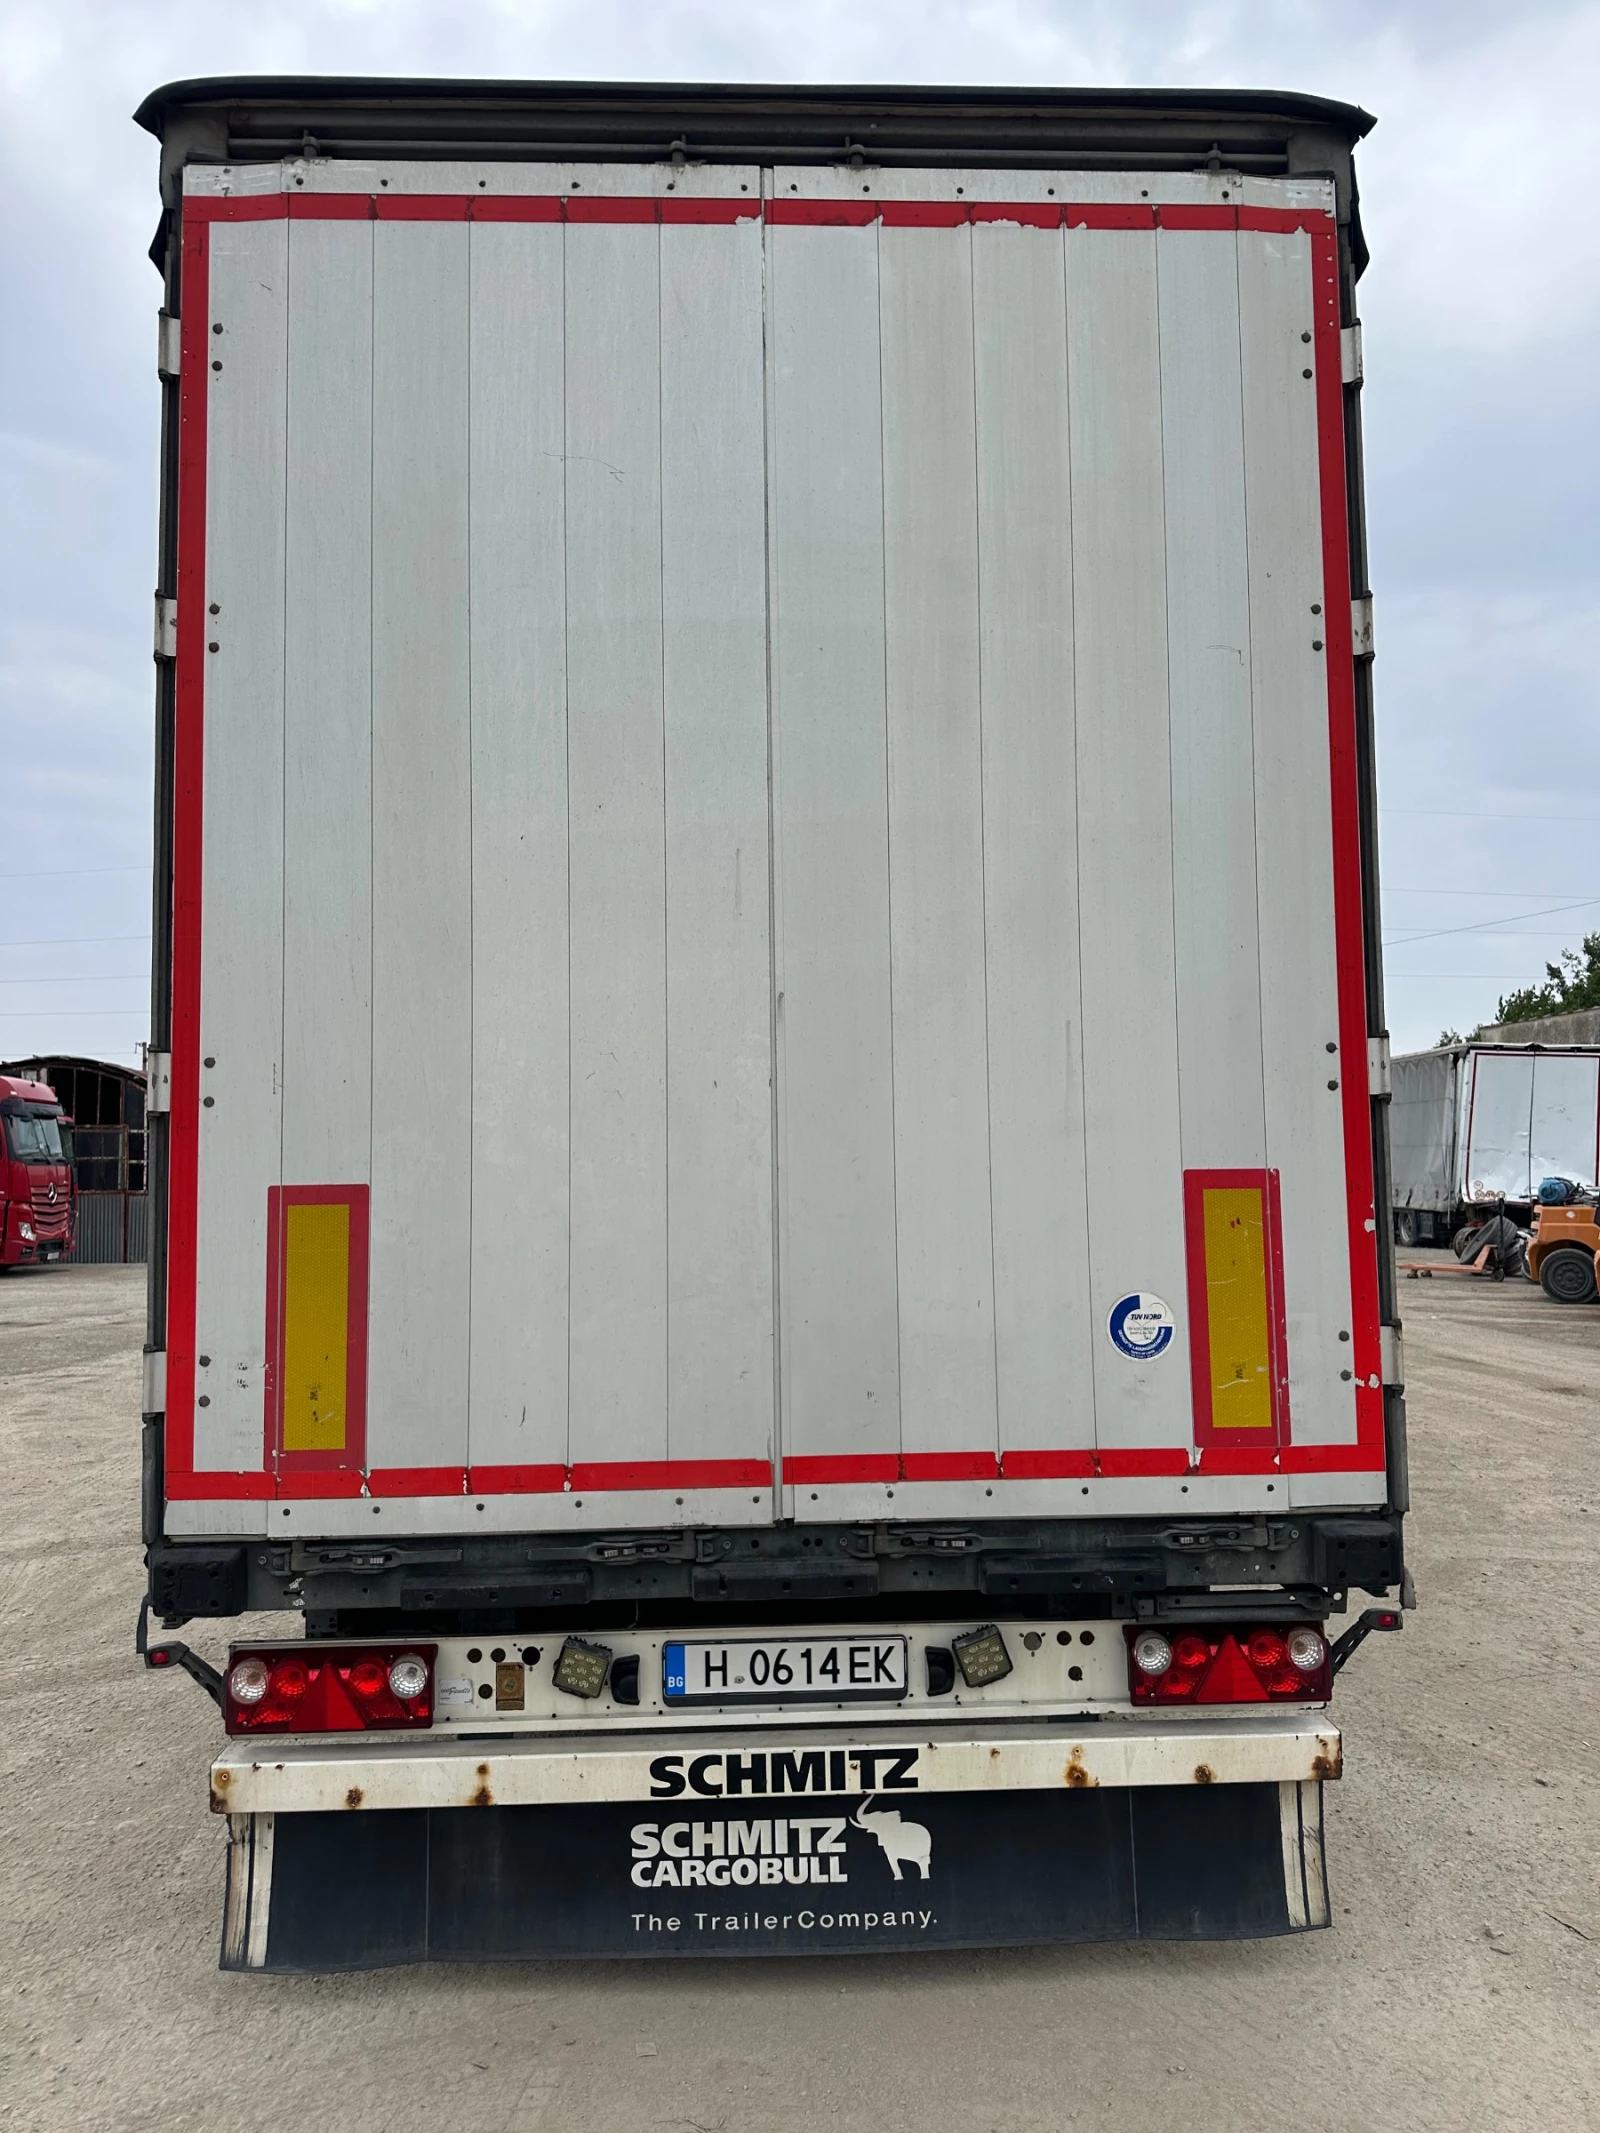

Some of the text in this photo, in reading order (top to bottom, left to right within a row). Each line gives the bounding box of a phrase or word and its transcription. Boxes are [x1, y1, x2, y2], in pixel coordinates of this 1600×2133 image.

[667, 1676, 684, 1688] BG
[649, 1748, 919, 1798] SCHMITZ
[630, 1817, 847, 1858] SCHMITZ
[630, 1856, 848, 1888] CARGOBULL
[631, 1914, 682, 1931] The
